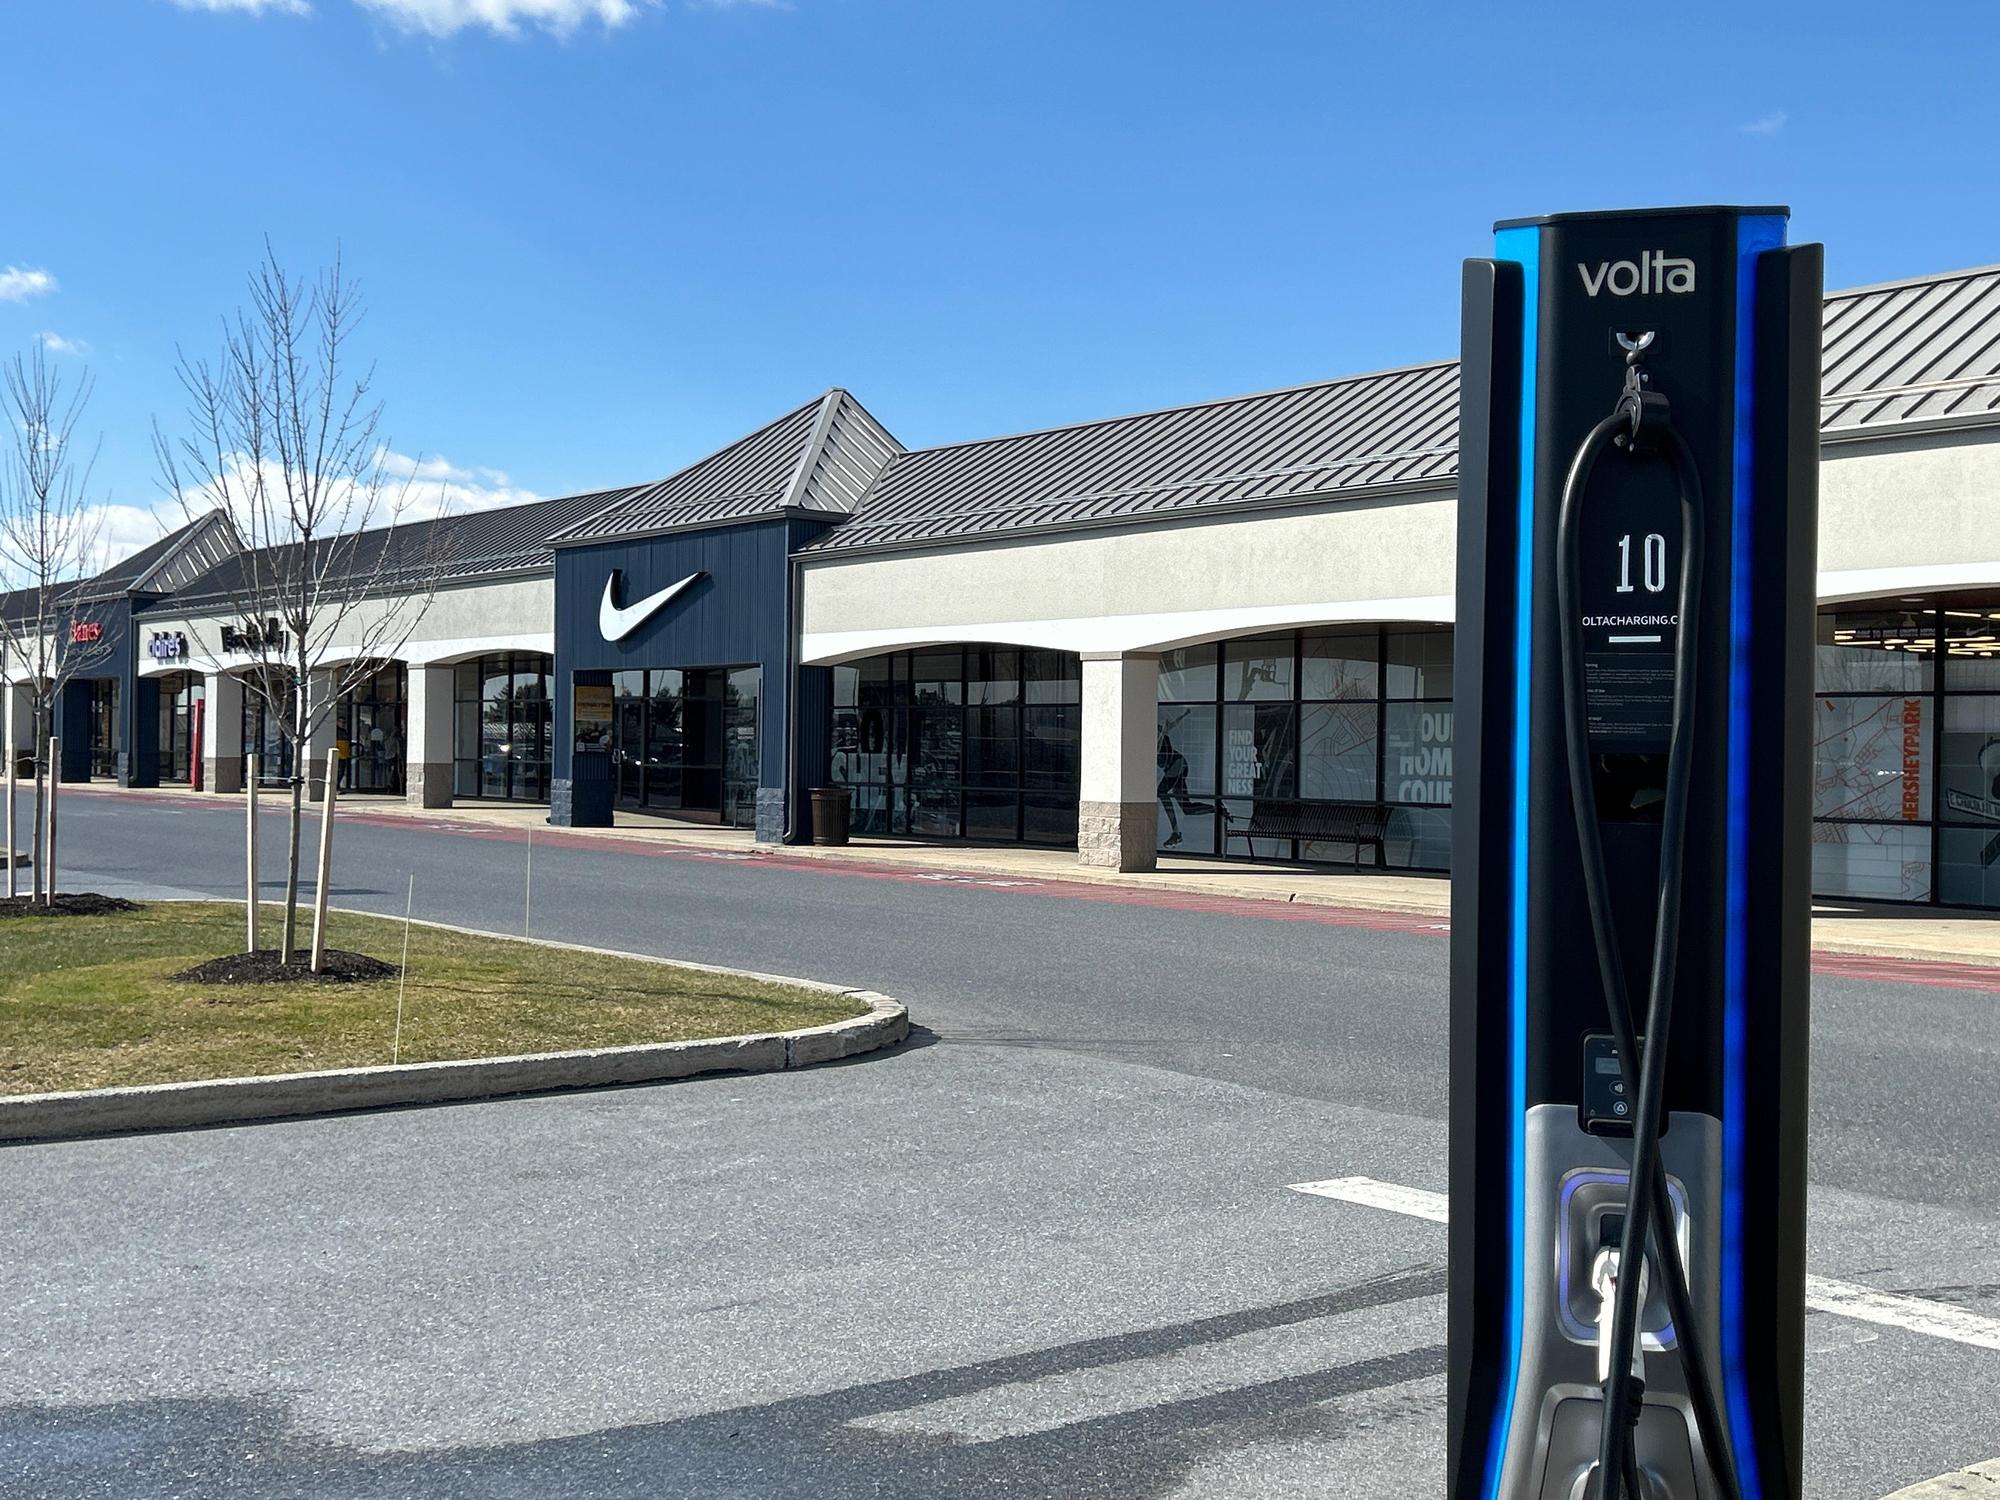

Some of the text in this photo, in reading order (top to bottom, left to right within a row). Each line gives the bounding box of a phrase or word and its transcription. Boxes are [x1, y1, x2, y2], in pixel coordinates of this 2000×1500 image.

[1577, 249, 1696, 297] volta
[1616, 533, 1666, 592] 10
[1582, 615, 1678, 626] OLTACHARGING.C
[1228, 729, 1253, 746] FIND
[1229, 746, 1258, 762] YOUR
[1400, 746, 1454, 776] HOM
[1902, 698, 1921, 822] HERSHEYPARK
[1228, 762, 1262, 779] GREAT
[1228, 779, 1253, 796] NESS
